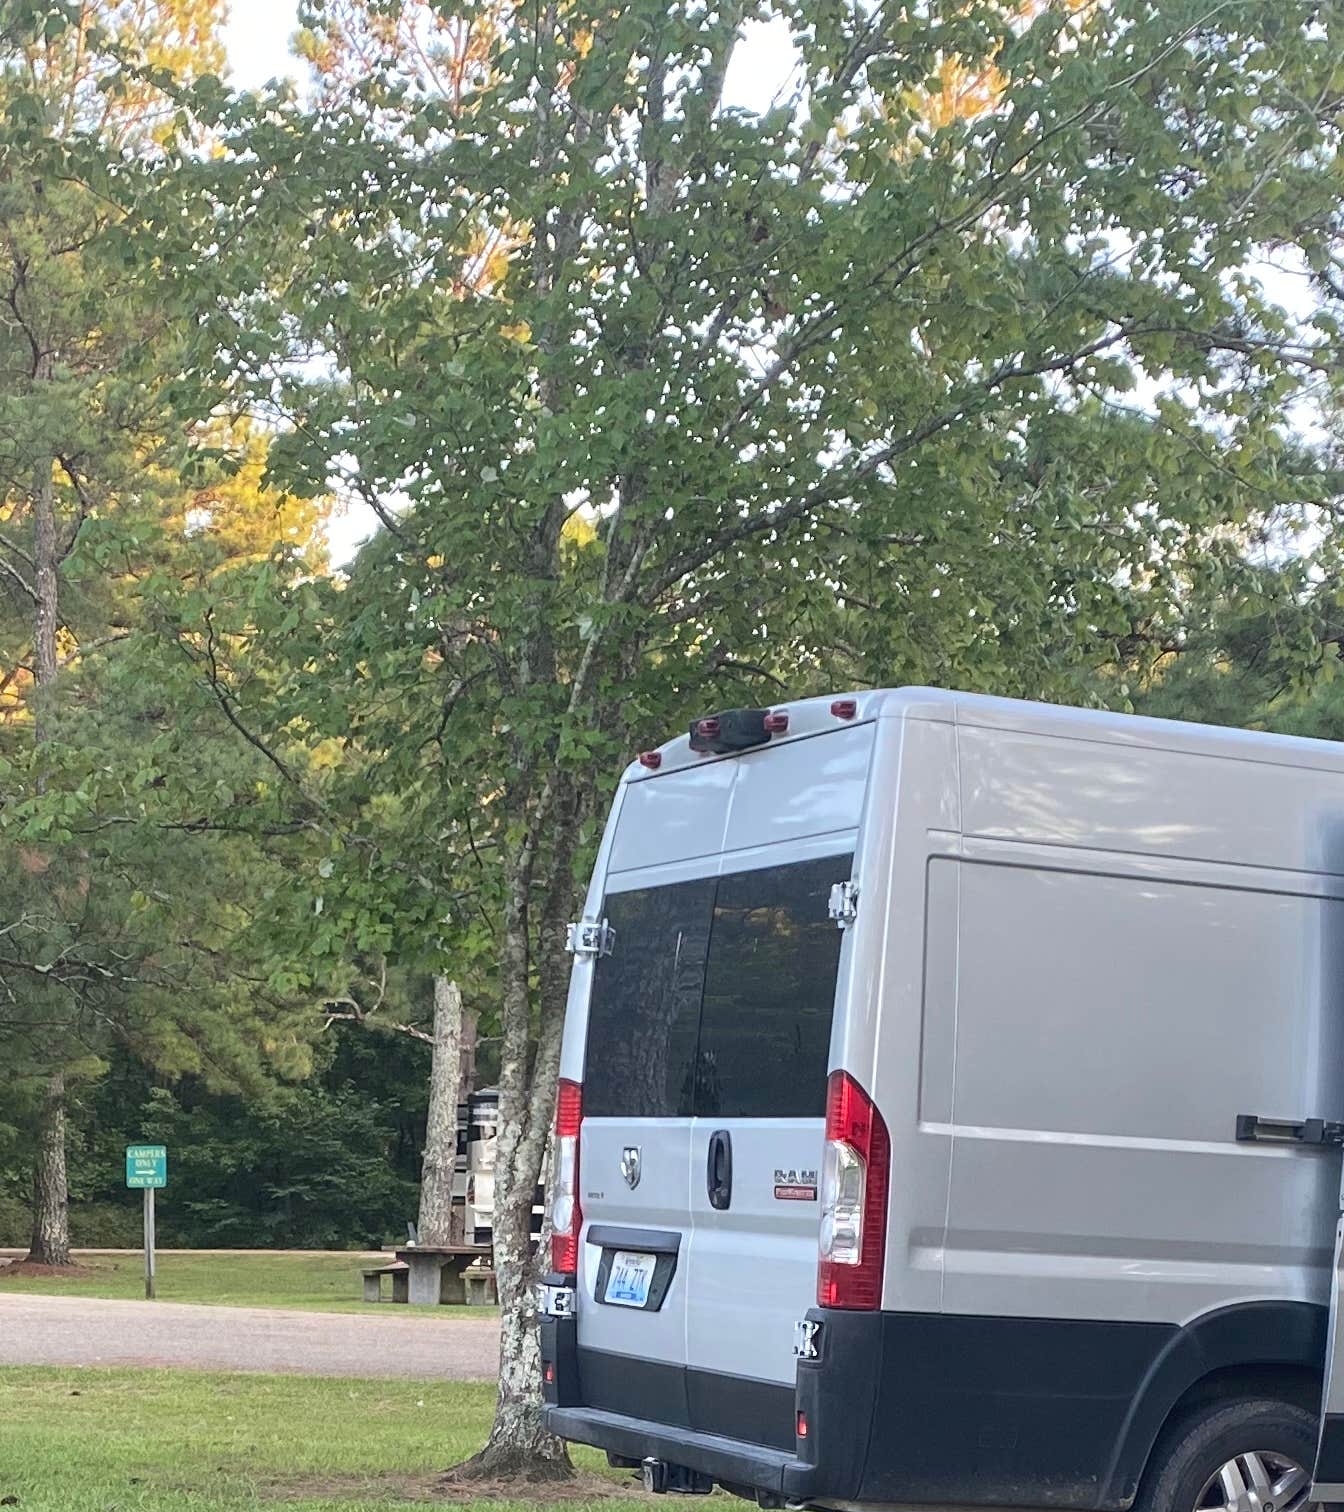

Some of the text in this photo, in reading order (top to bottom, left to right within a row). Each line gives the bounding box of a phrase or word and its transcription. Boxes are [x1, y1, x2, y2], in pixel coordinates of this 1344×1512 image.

[127, 1150, 166, 1159] CAMPERS
[136, 1159, 156, 1168] ONLY
[129, 1177, 163, 1185] ONE WAY
[774, 1169, 818, 1185] RAM
